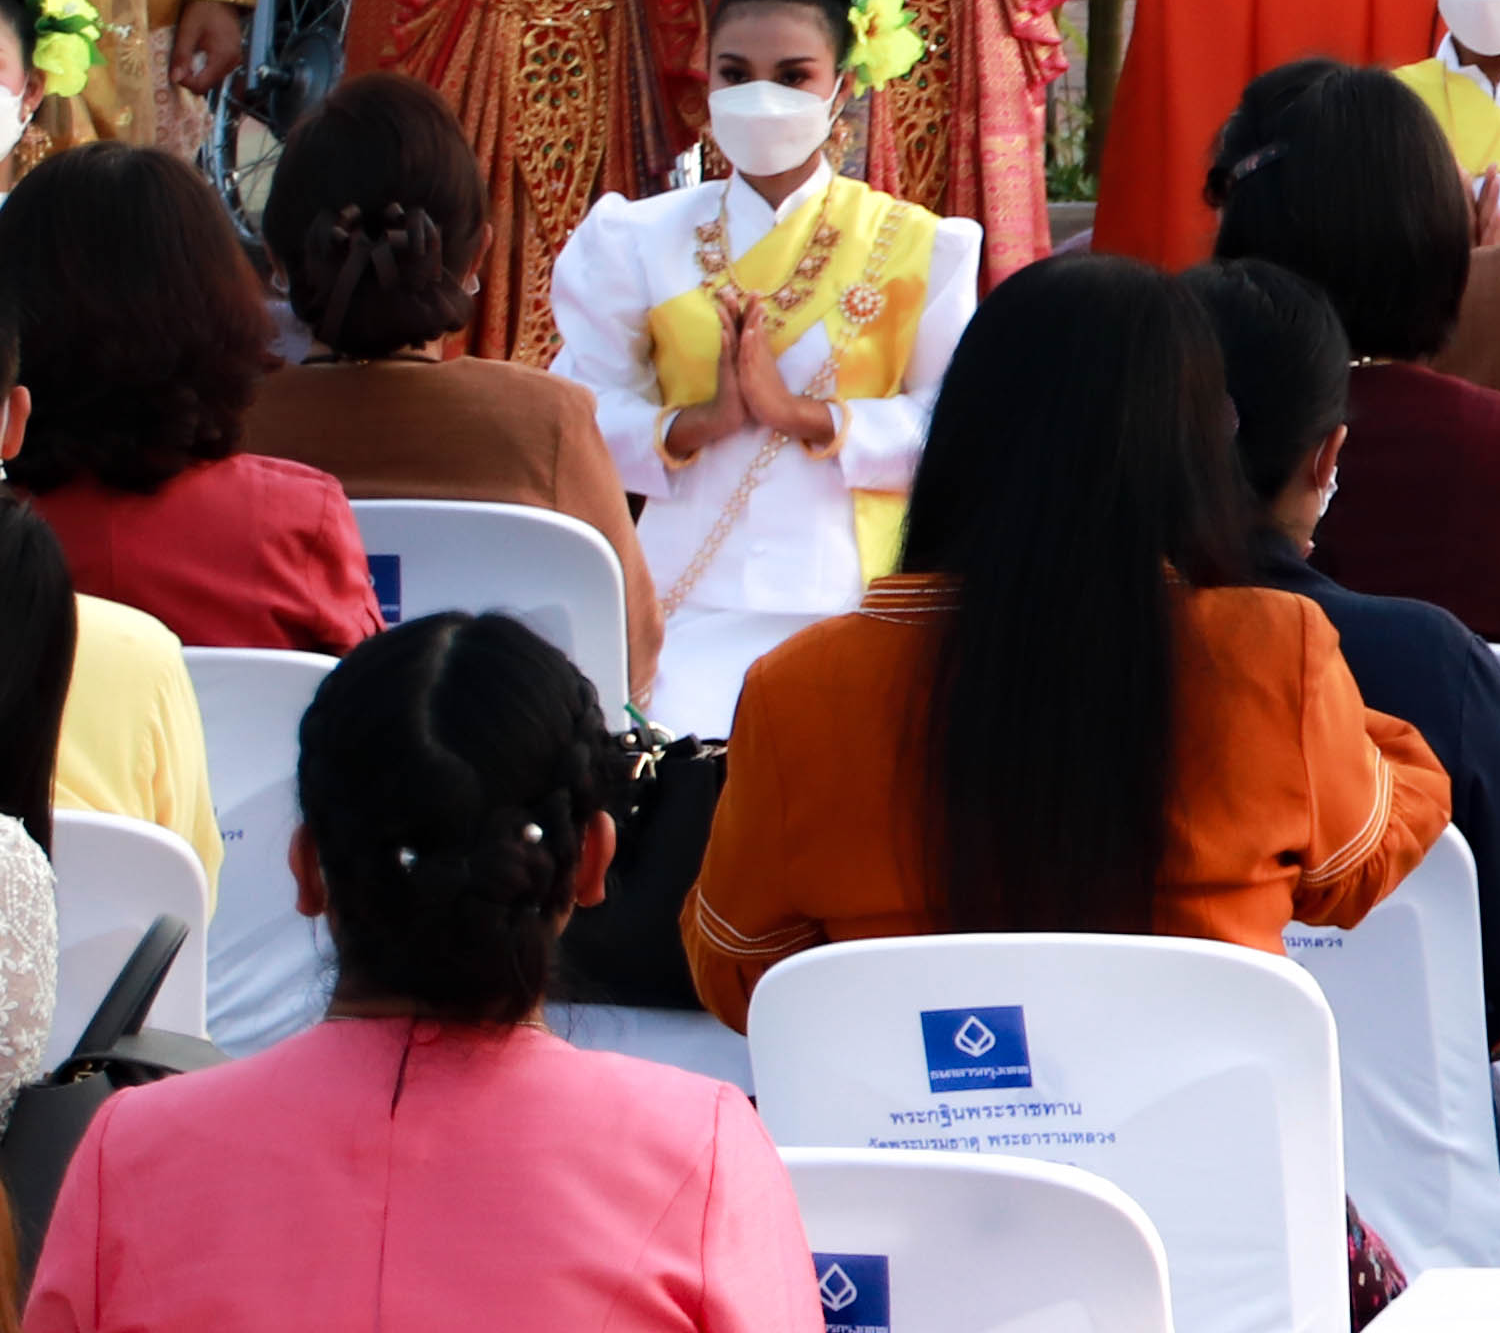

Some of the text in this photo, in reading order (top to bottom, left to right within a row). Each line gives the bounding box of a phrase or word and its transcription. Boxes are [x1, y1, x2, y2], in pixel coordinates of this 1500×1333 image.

[889, 1099, 1083, 1129] พระกฐินพระราชทาน
[987, 1130, 1117, 1148] พระอารามหลวง
